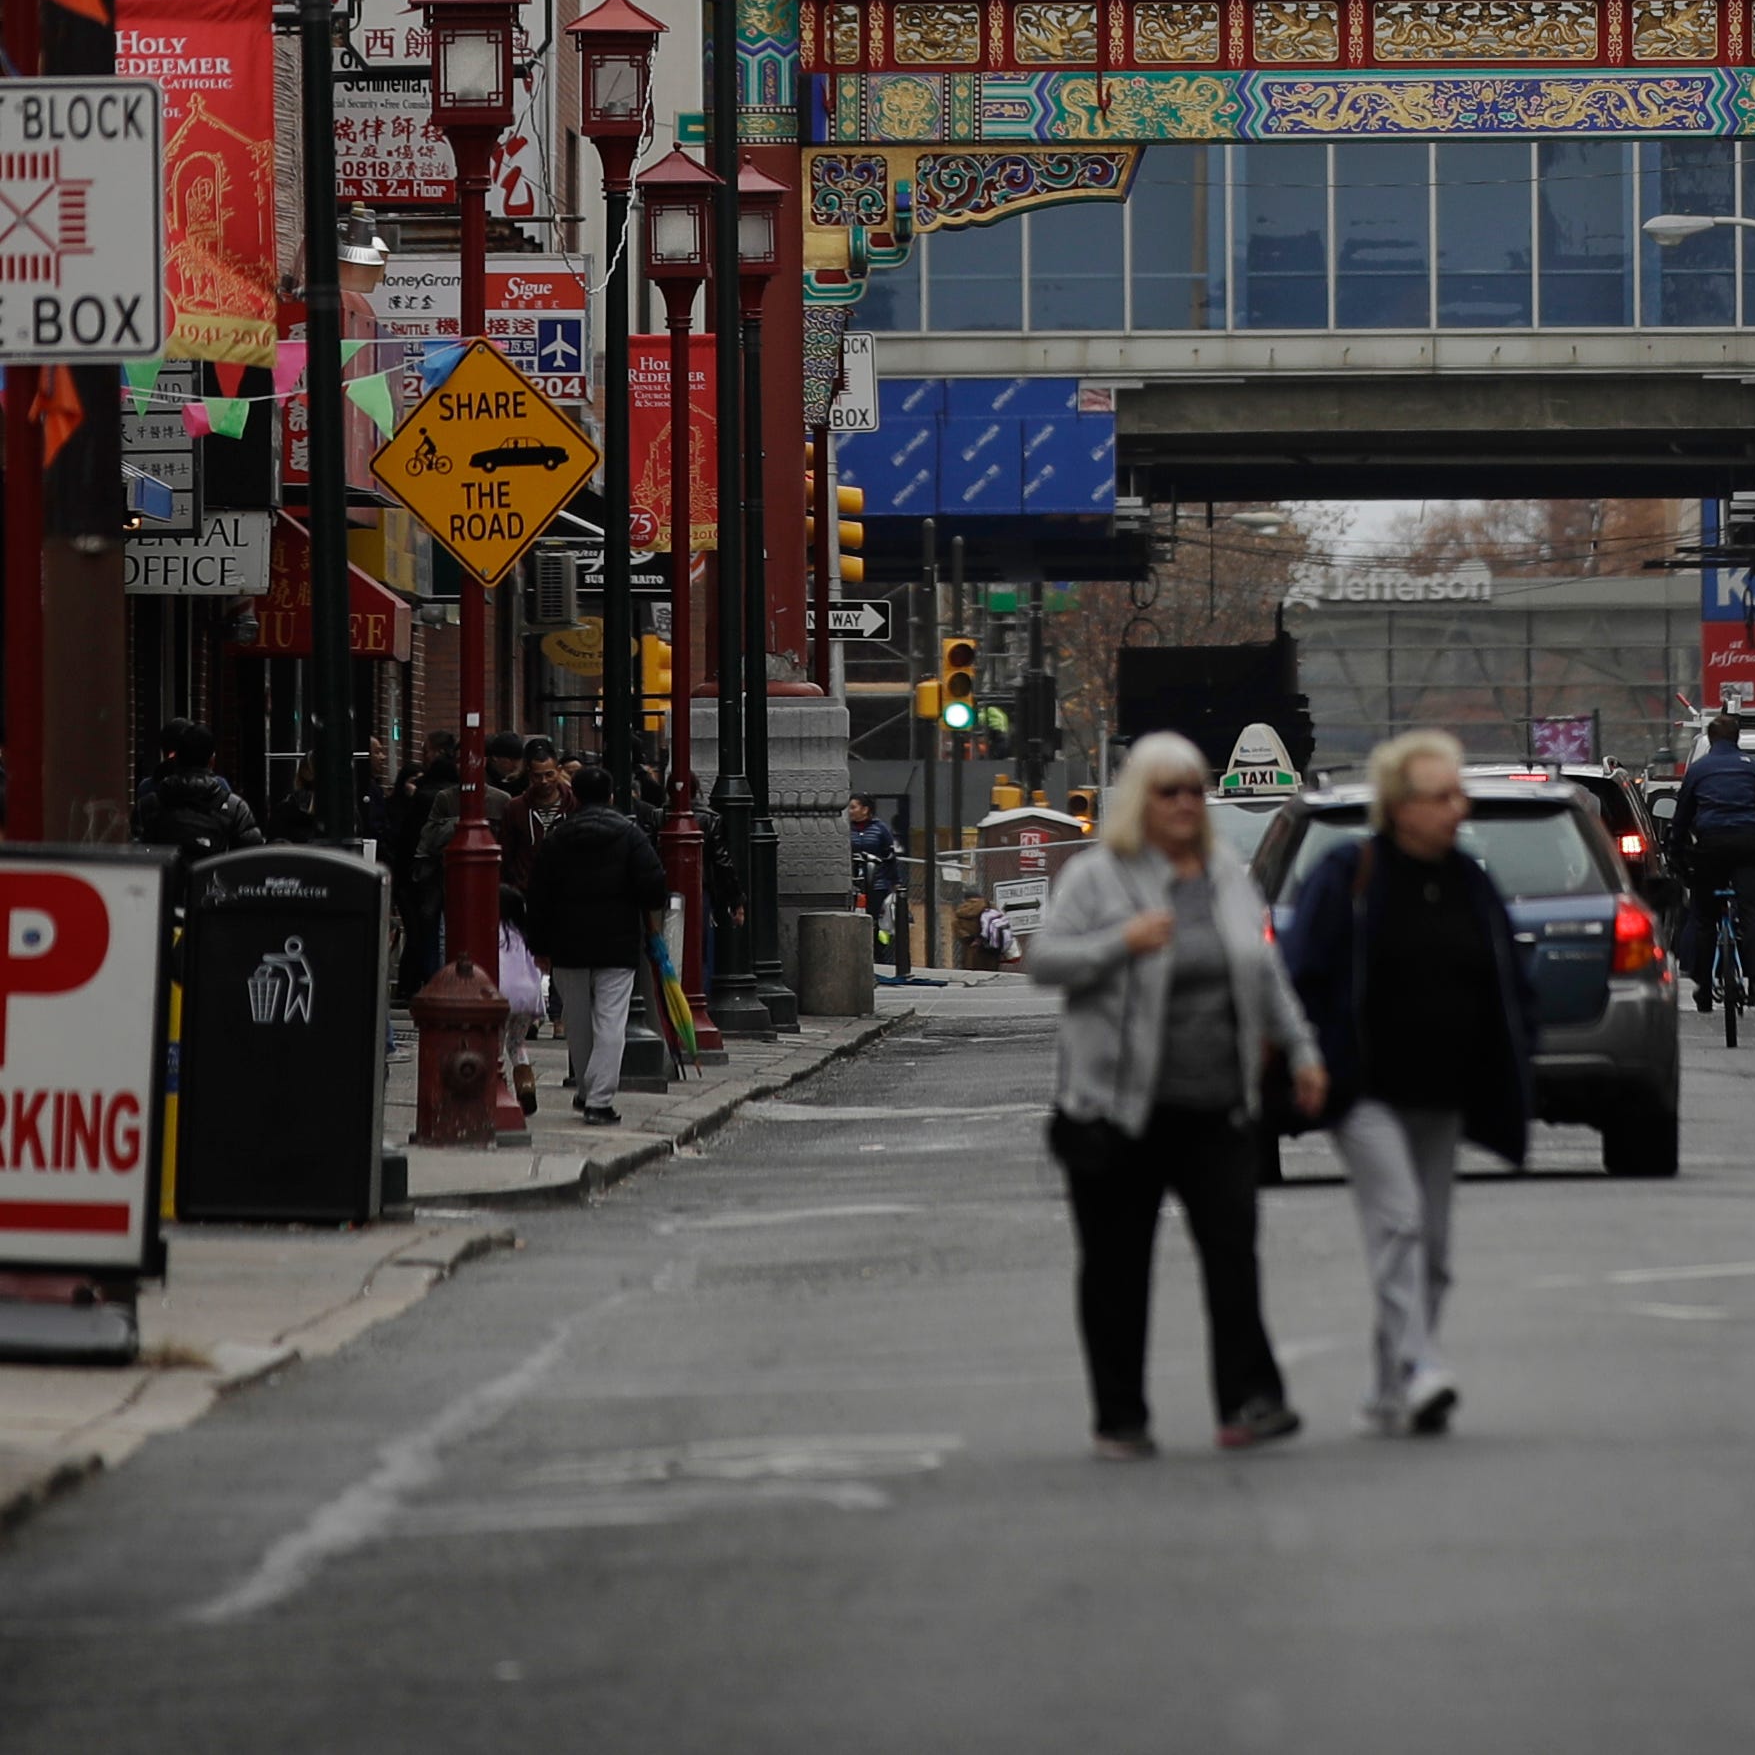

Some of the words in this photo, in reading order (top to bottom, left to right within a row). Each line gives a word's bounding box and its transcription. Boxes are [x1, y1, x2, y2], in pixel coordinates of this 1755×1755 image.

[115, 58, 232, 76] EDEEMER
[22, 95, 144, 140] BLOCK
[504, 276, 553, 301] Sigue
[32, 295, 142, 346] BOX
[435, 317, 536, 336] 機接送
[842, 337, 870, 355] OCK
[639, 356, 672, 371] HOL
[438, 391, 527, 422] SHARE
[832, 408, 870, 427] BOX
[461, 480, 511, 509] THE
[449, 512, 525, 543] ROAD
[1329, 567, 1492, 602] Jefferson
[831, 608, 862, 627] WAY
[1240, 770, 1274, 786] TAXI
